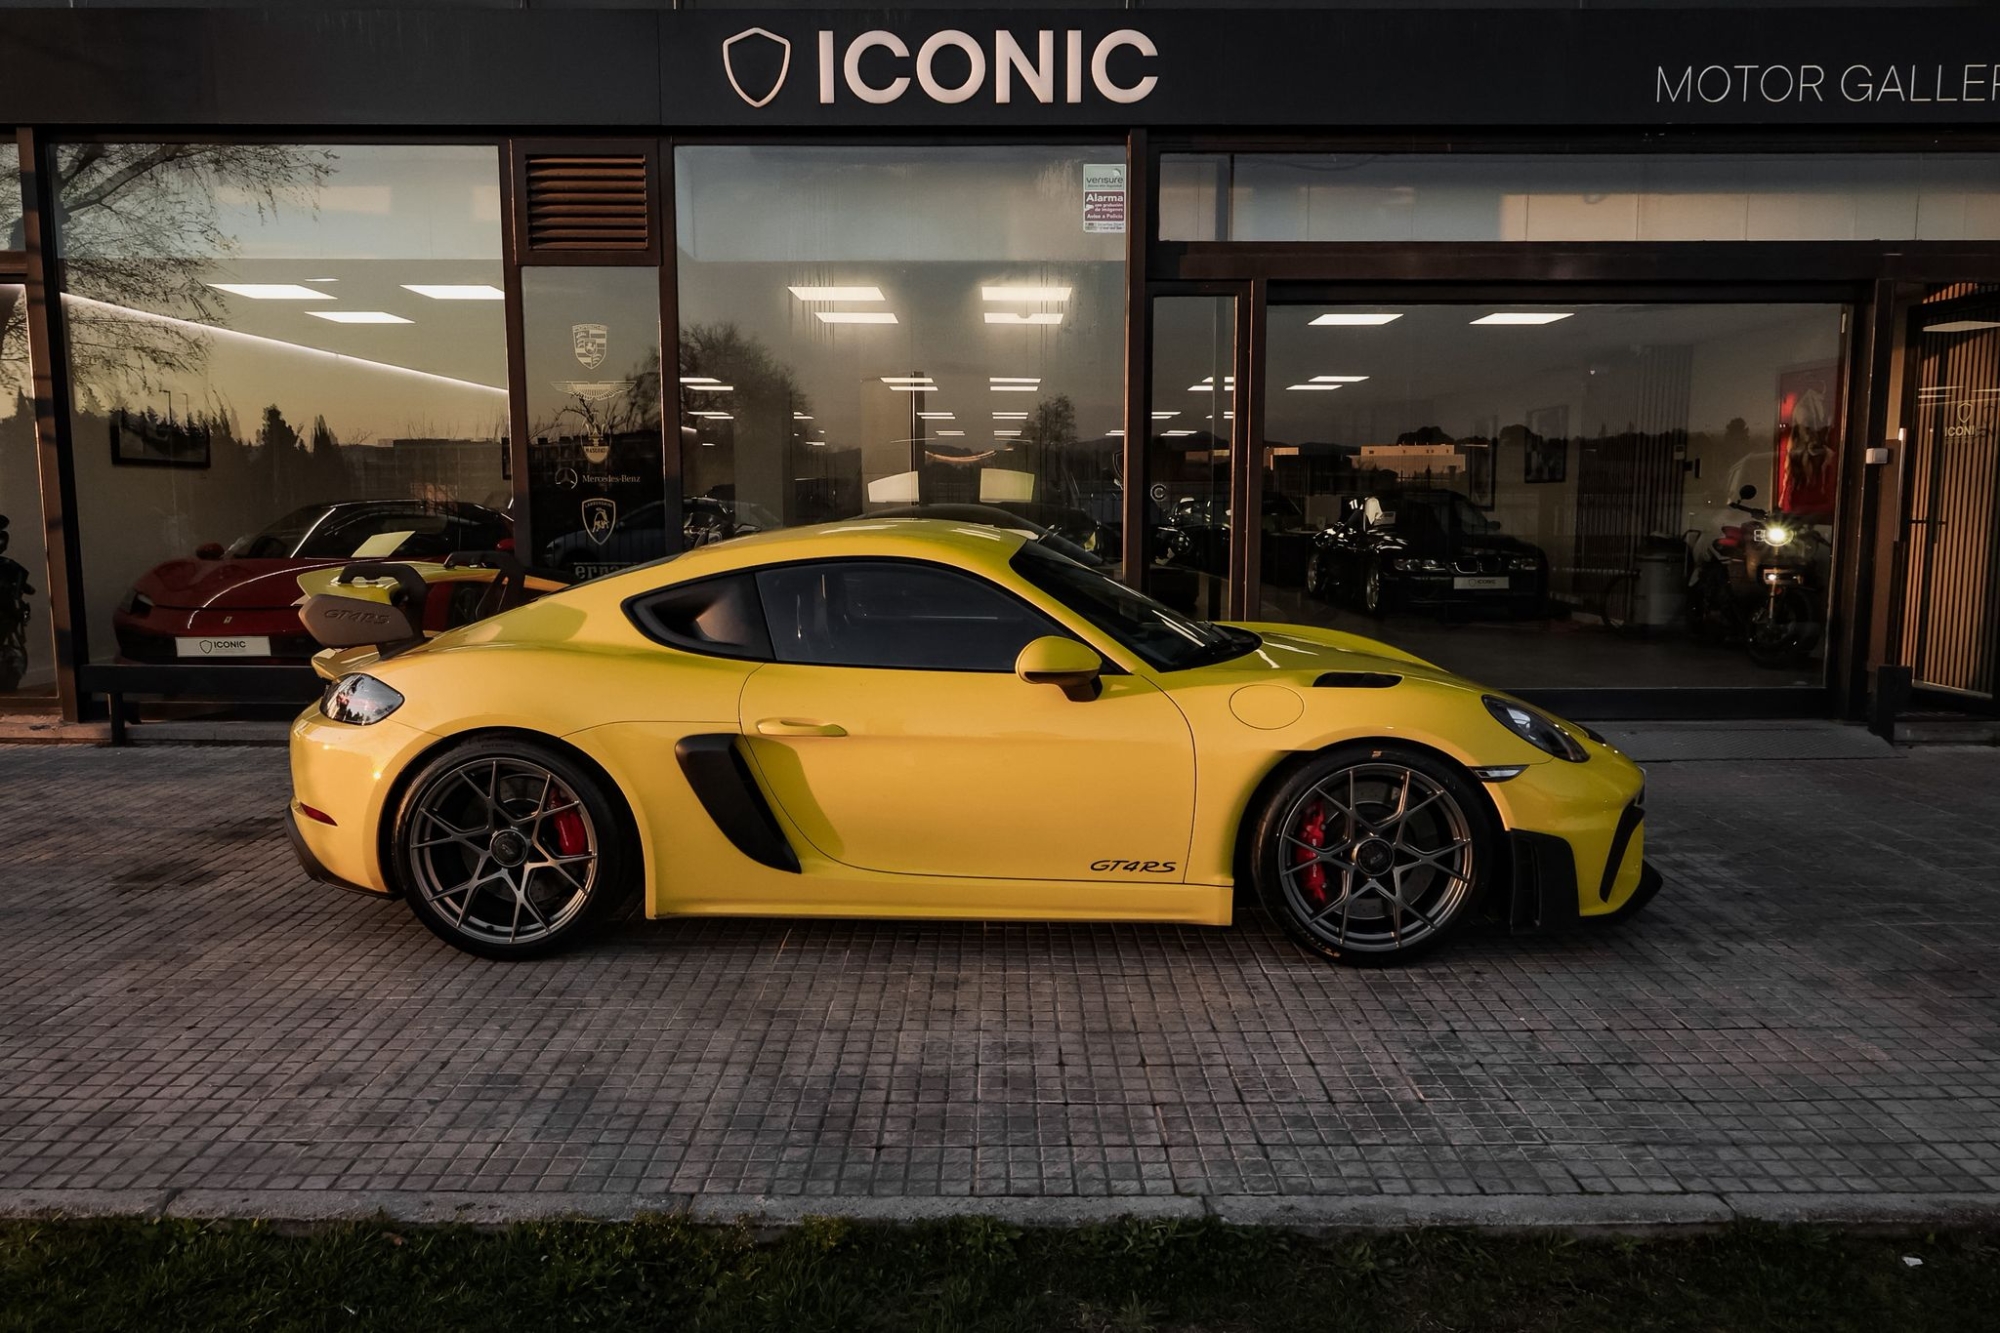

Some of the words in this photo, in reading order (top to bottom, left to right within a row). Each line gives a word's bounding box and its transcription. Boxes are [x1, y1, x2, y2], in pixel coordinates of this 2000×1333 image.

[819, 29, 1159, 104] ICONIC
[1656, 65, 1824, 103] MOTOR
[1841, 65, 2000, 103] GALLE
[1086, 193, 1124, 202] Alarma
[582, 474, 641, 483] Mercedes-Benz
[324, 609, 391, 625] GT4RS
[213, 641, 247, 649] ICONIC
[1090, 860, 1177, 873] GT4RS
